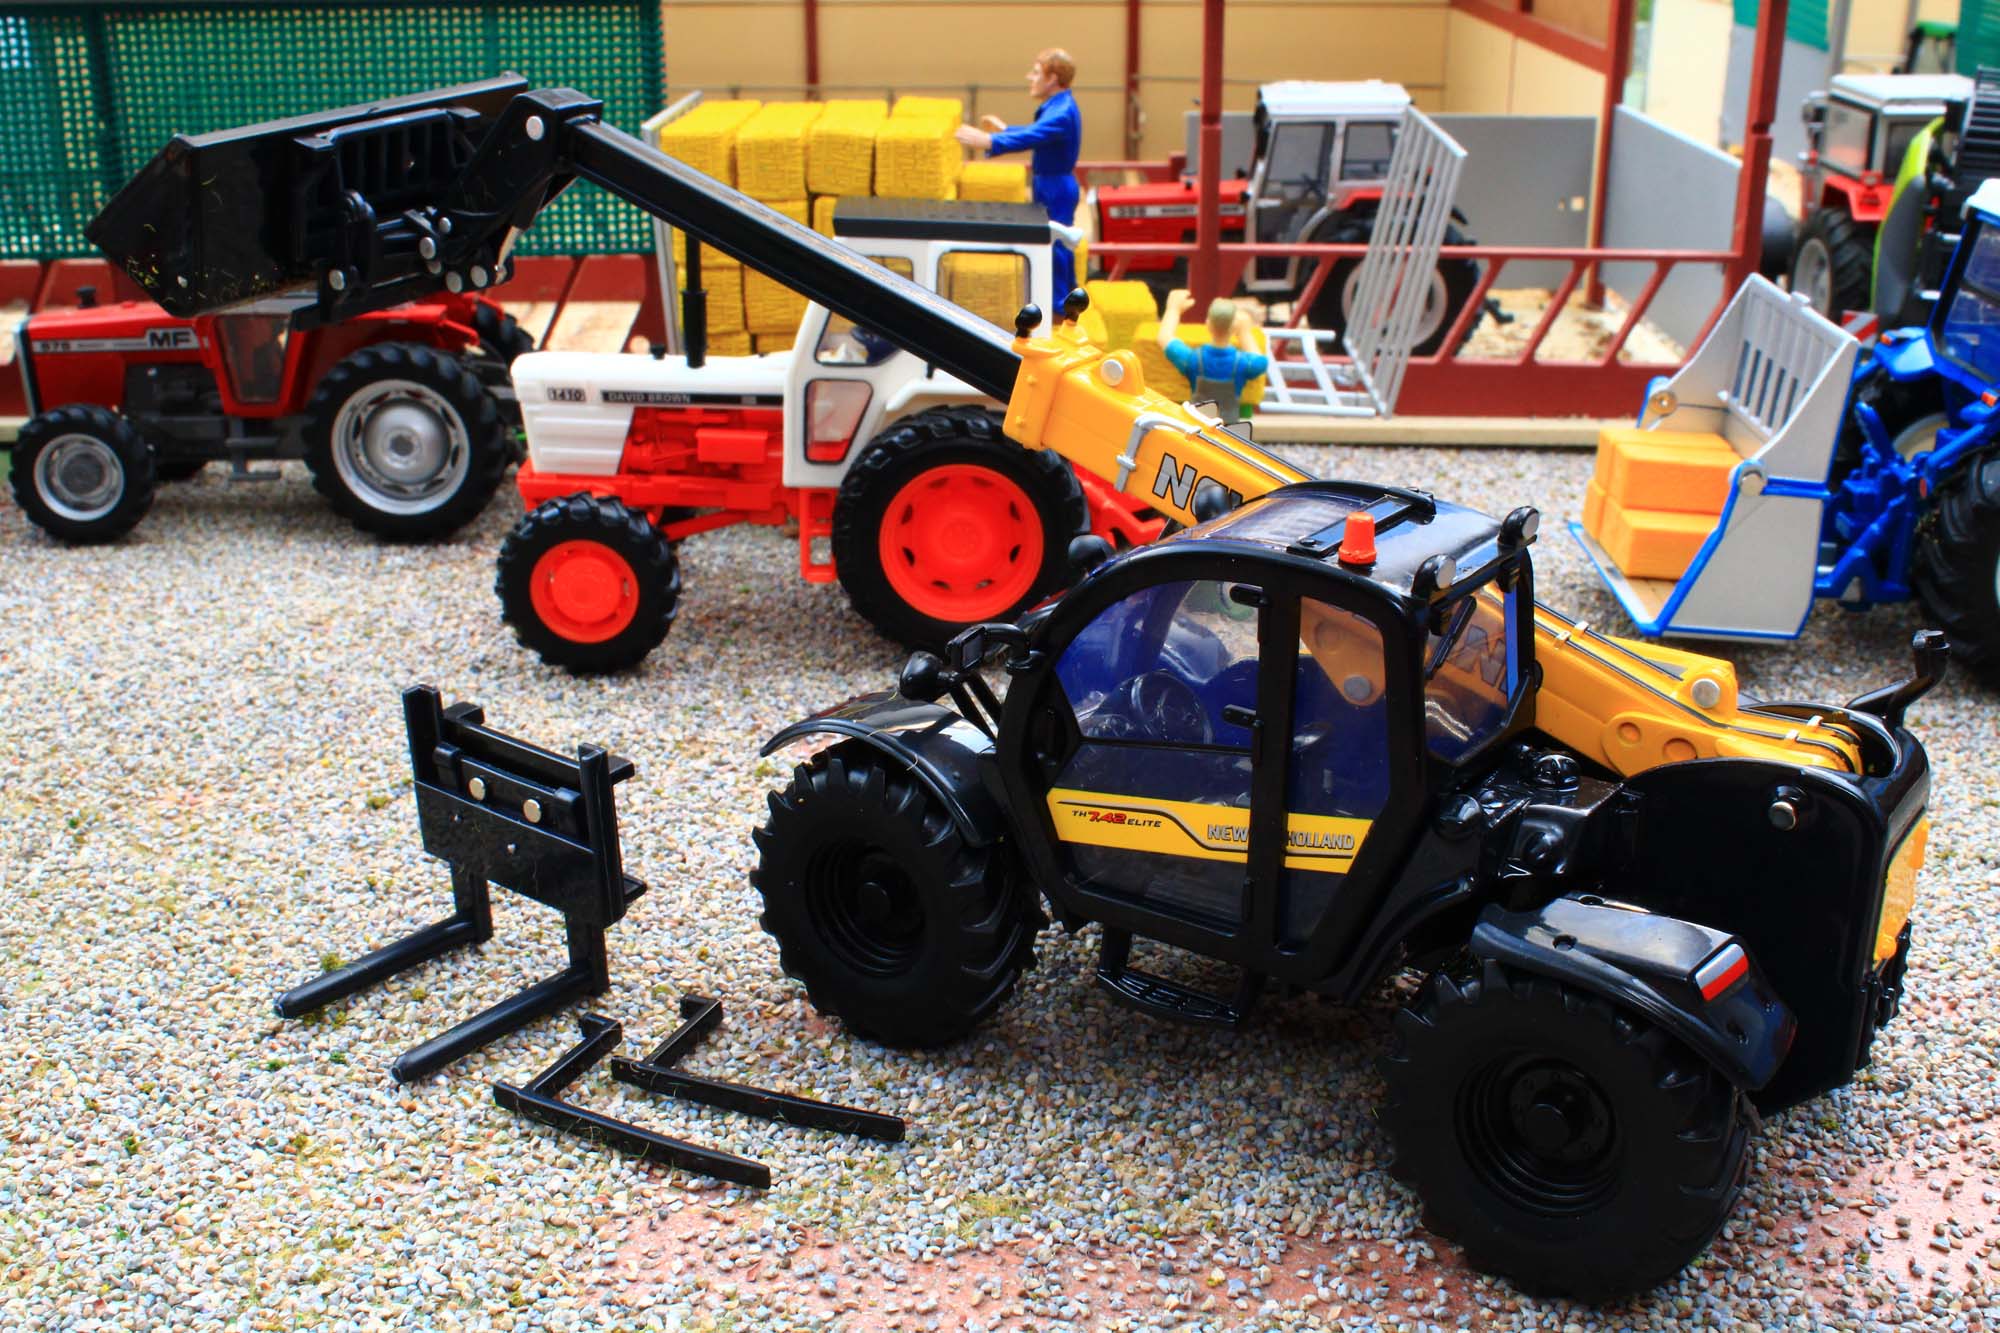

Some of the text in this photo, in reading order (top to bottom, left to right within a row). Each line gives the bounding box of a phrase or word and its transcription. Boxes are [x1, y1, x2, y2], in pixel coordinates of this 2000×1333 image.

[150, 331, 192, 348] MF
[608, 391, 691, 403] DAVID BROWN
[1127, 818, 1162, 828] ELITE
[1207, 824, 1249, 842] NEW
